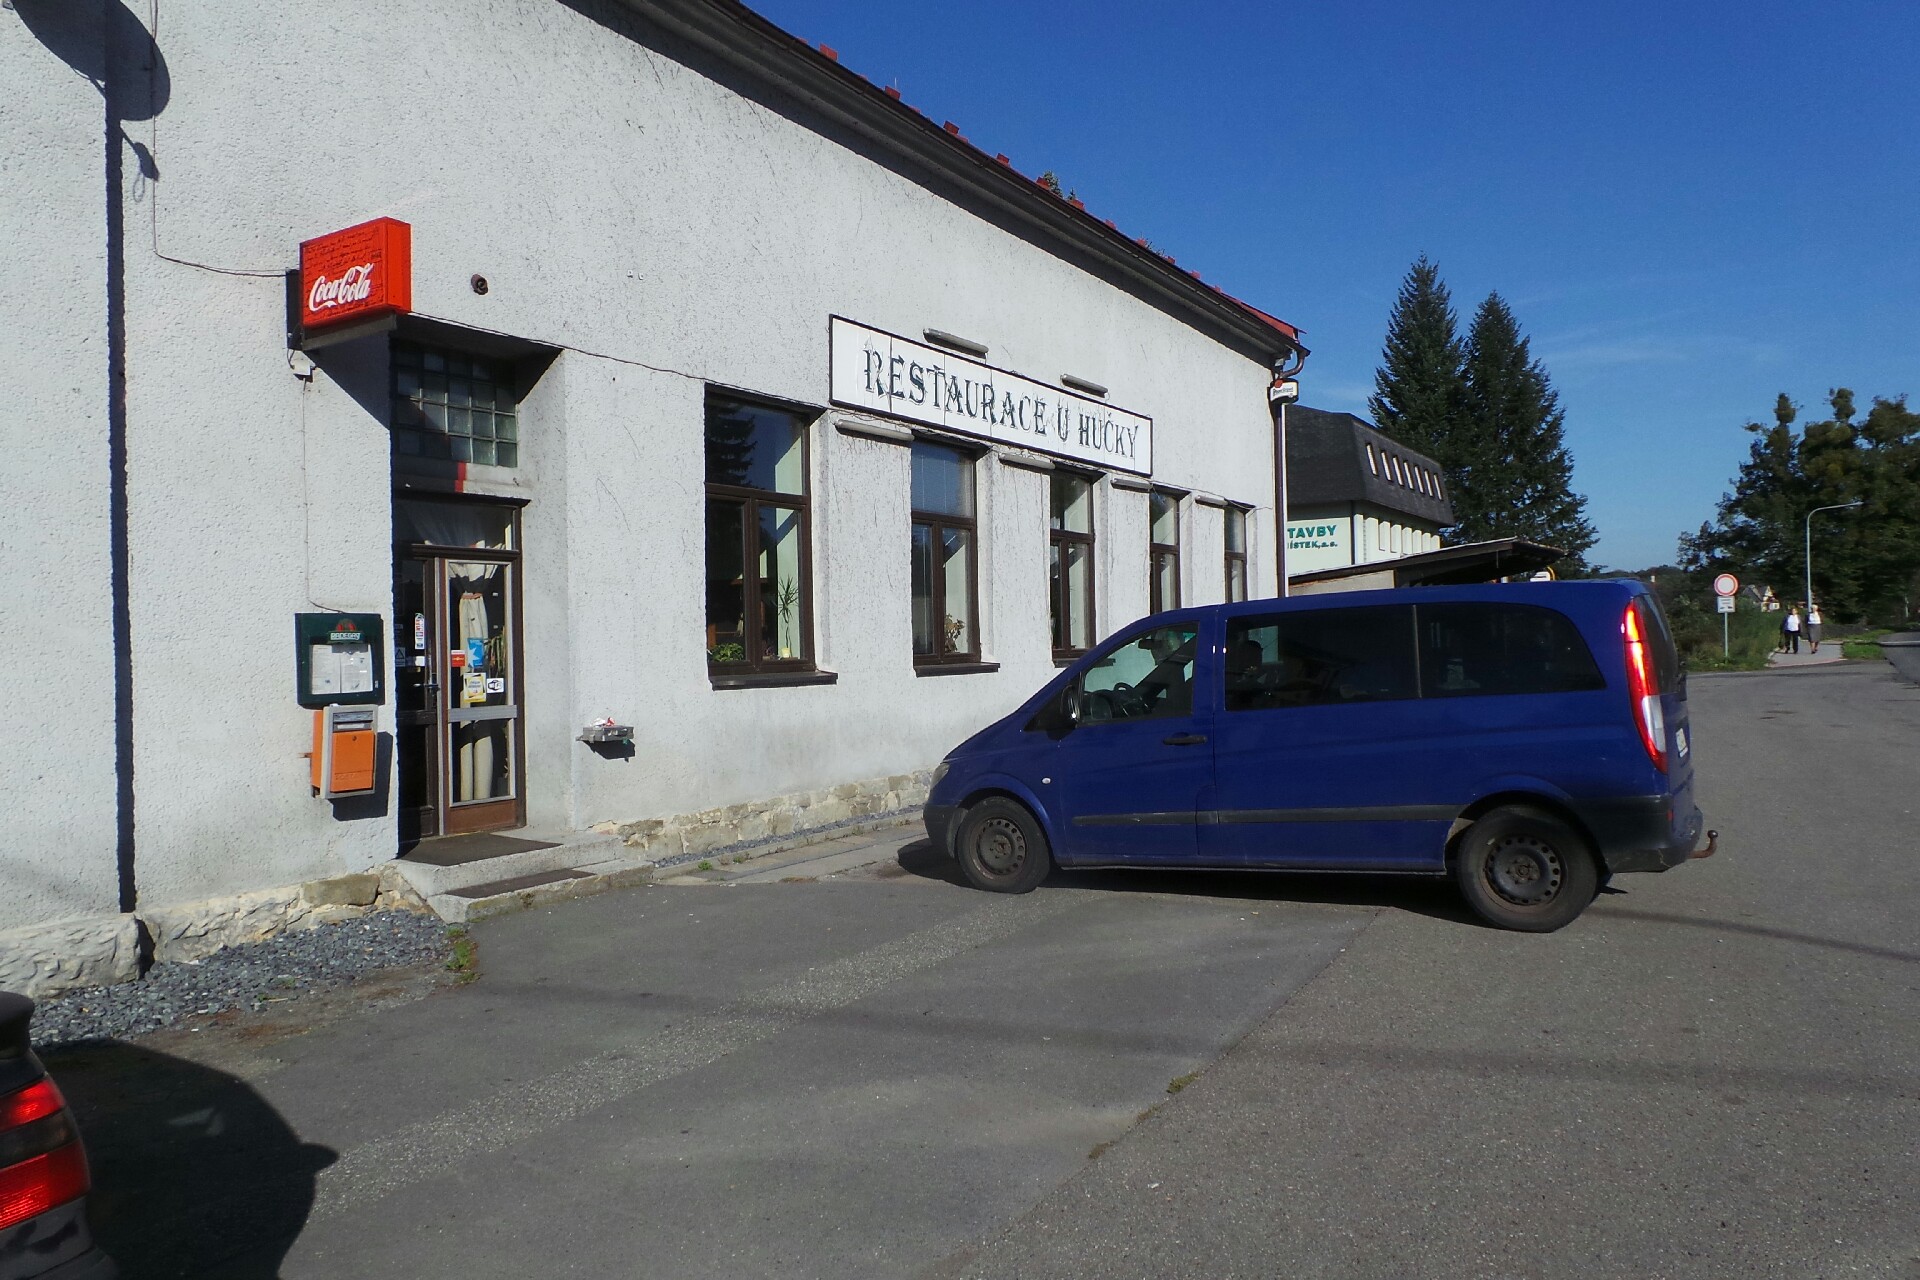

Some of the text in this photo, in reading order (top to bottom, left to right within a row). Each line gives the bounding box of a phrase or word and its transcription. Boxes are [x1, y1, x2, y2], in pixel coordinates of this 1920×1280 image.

[863, 349, 1139, 458] RESTAURACE U HUČKY
[1287, 525, 1337, 539] TAVBY
